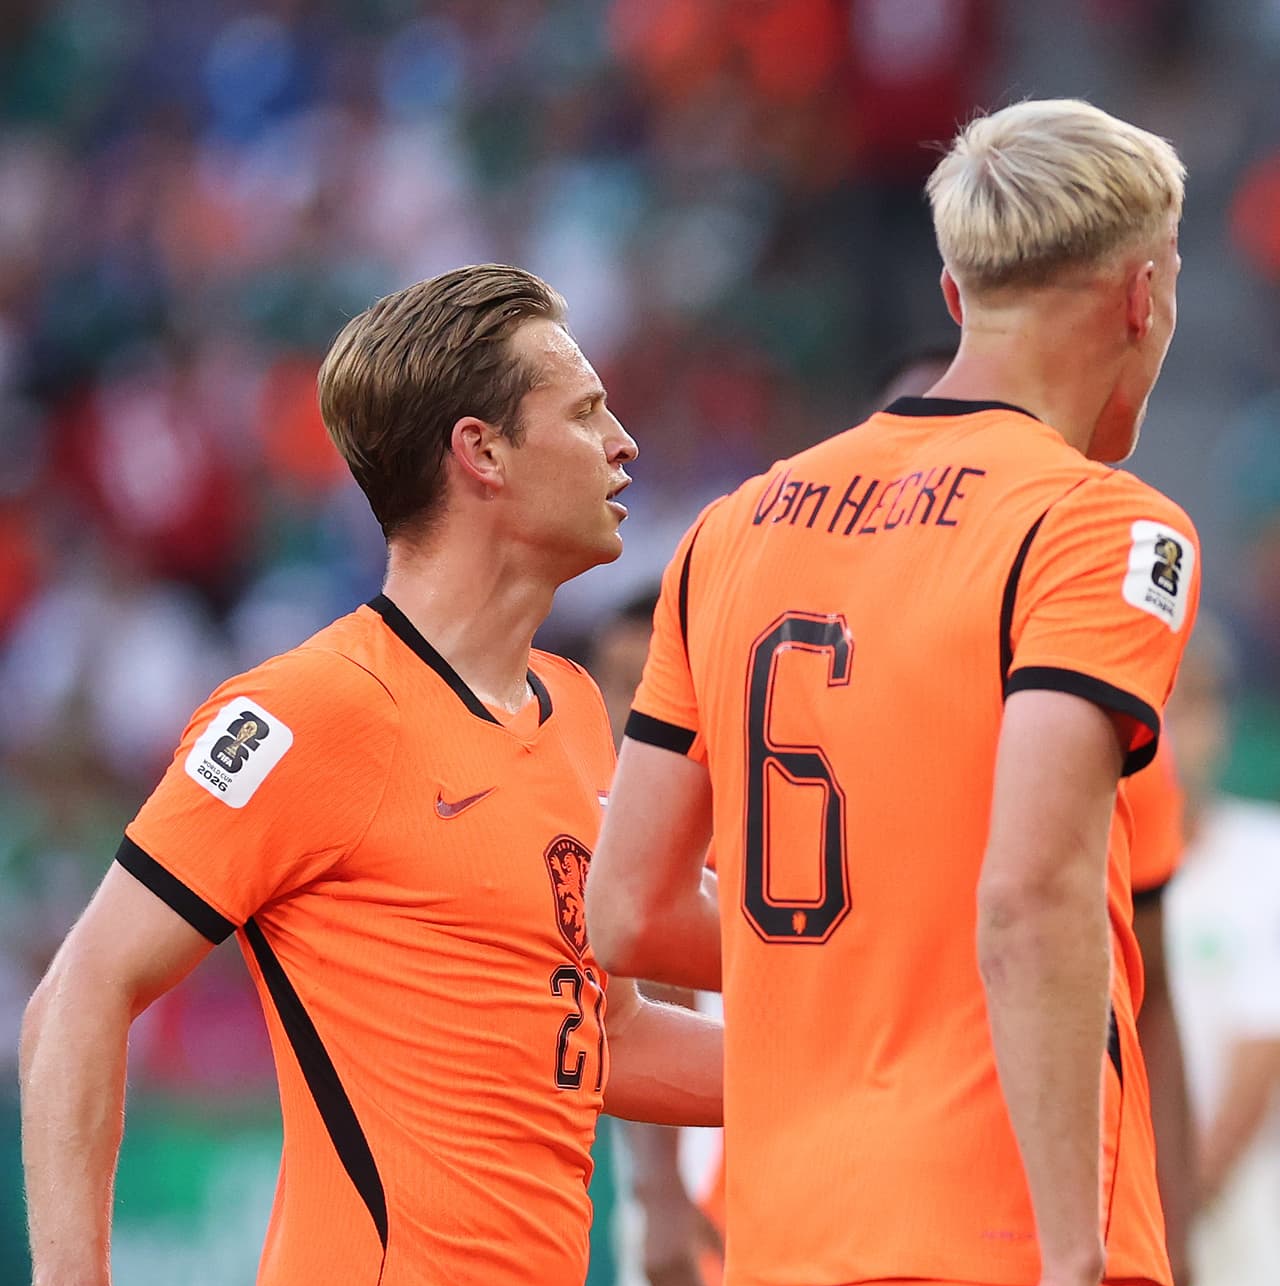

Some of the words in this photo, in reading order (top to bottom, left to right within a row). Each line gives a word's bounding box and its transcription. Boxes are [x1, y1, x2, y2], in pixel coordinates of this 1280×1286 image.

[827, 466, 986, 536] HECKE
[197, 765, 228, 792] 2026
[203, 759, 221, 775] WORLD
[220, 772, 233, 783] CUP
[741, 611, 854, 944] 6
